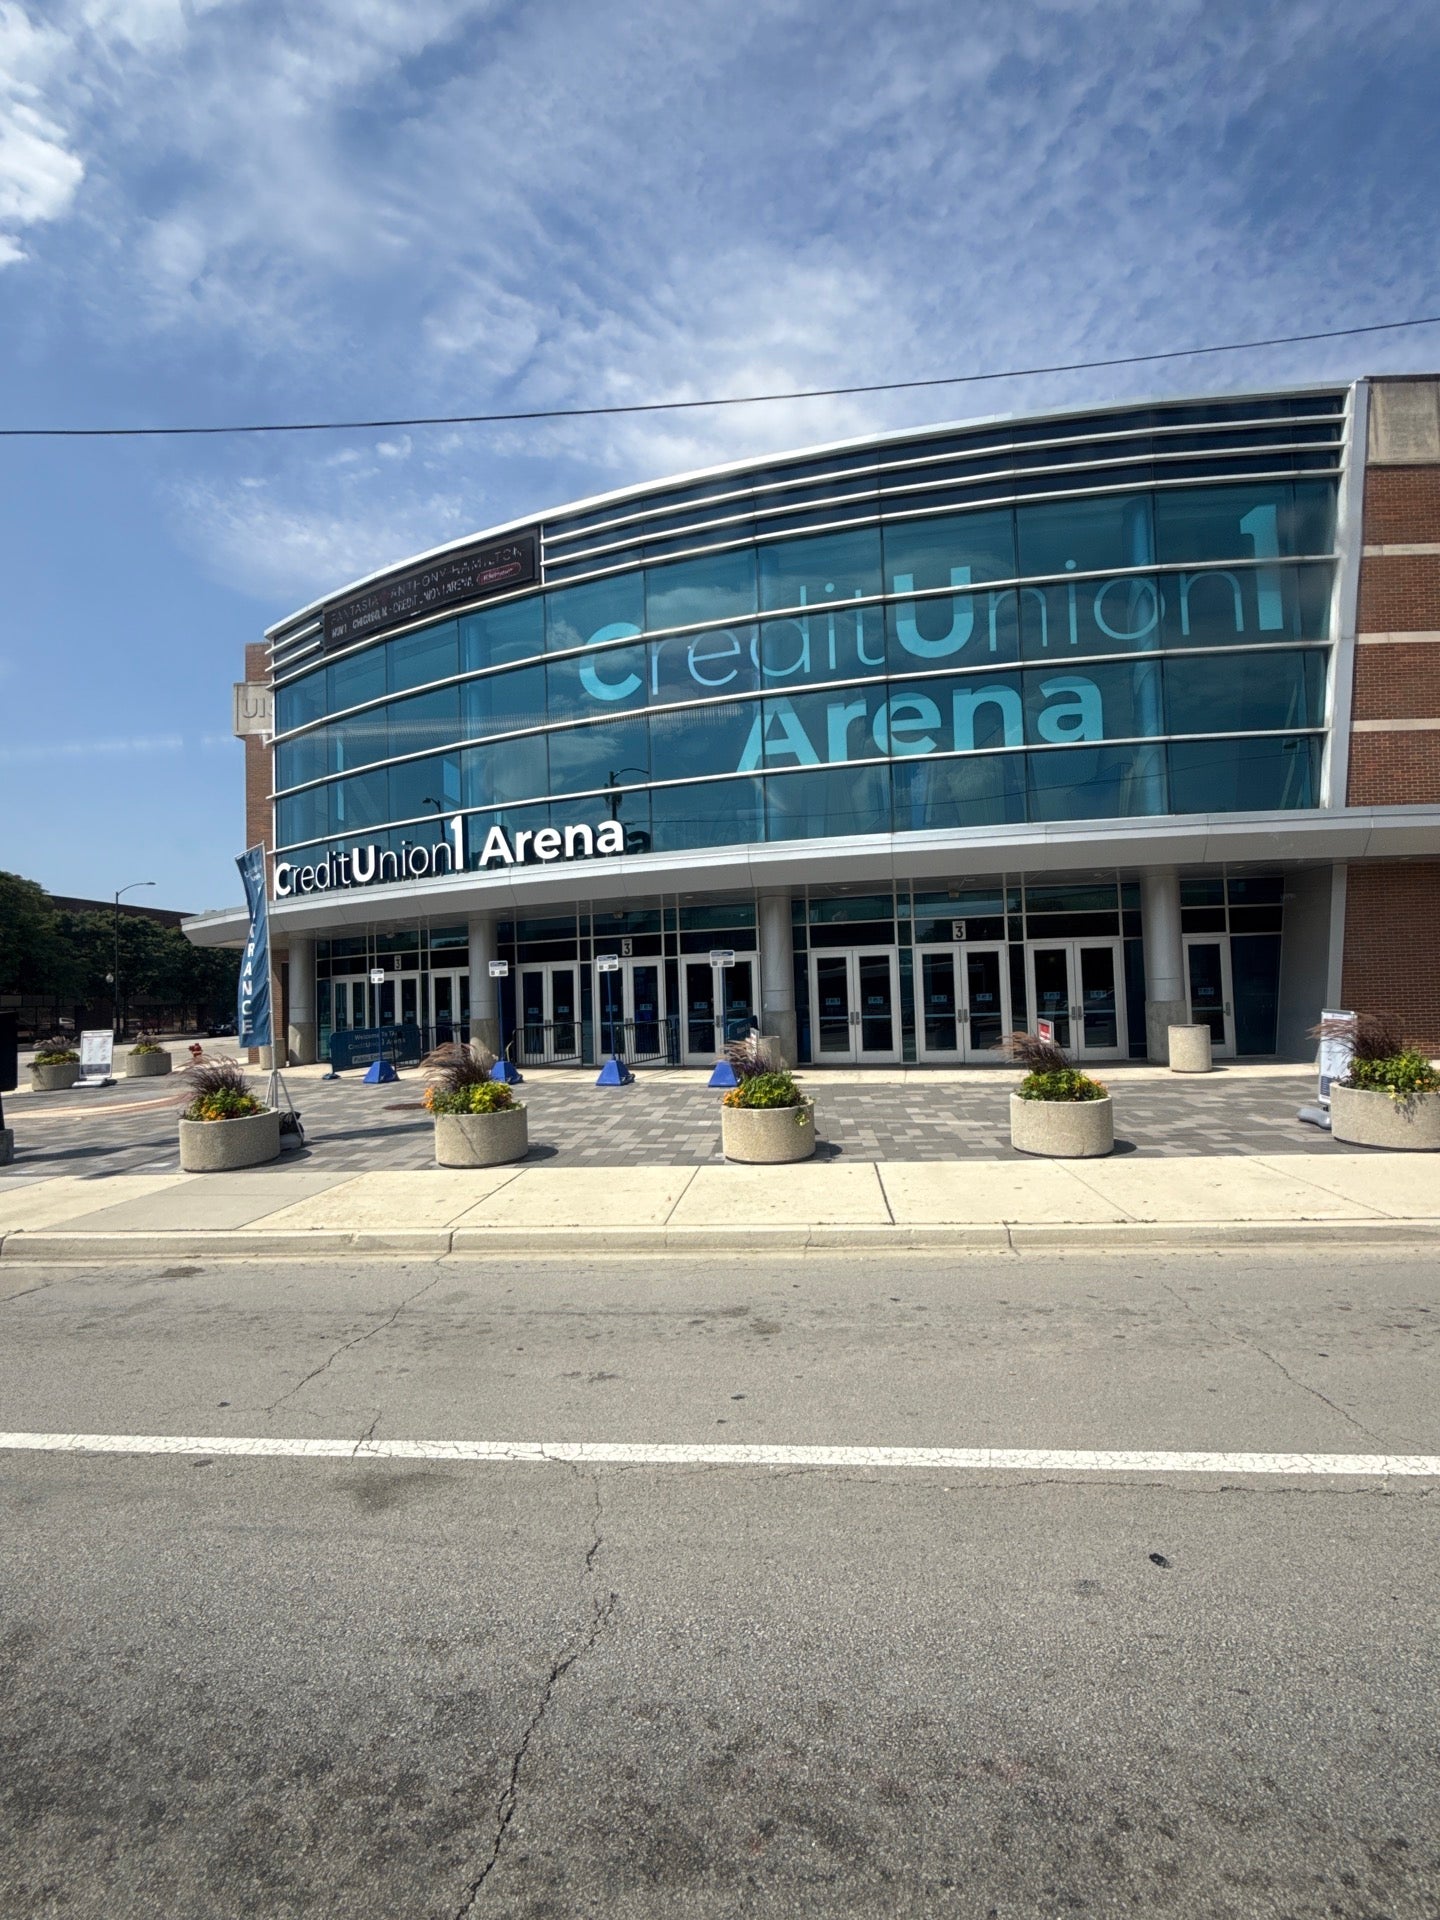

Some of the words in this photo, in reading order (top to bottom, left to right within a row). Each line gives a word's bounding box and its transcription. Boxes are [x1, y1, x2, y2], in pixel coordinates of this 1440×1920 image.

[579, 504, 1284, 700] CreditUnion1
[243, 698, 273, 718] UI
[736, 675, 1104, 773] Arena
[275, 815, 464, 896] CreditUnion1
[479, 820, 624, 866] Arena
[624, 942, 631, 955] 3
[955, 925, 964, 939] 3
